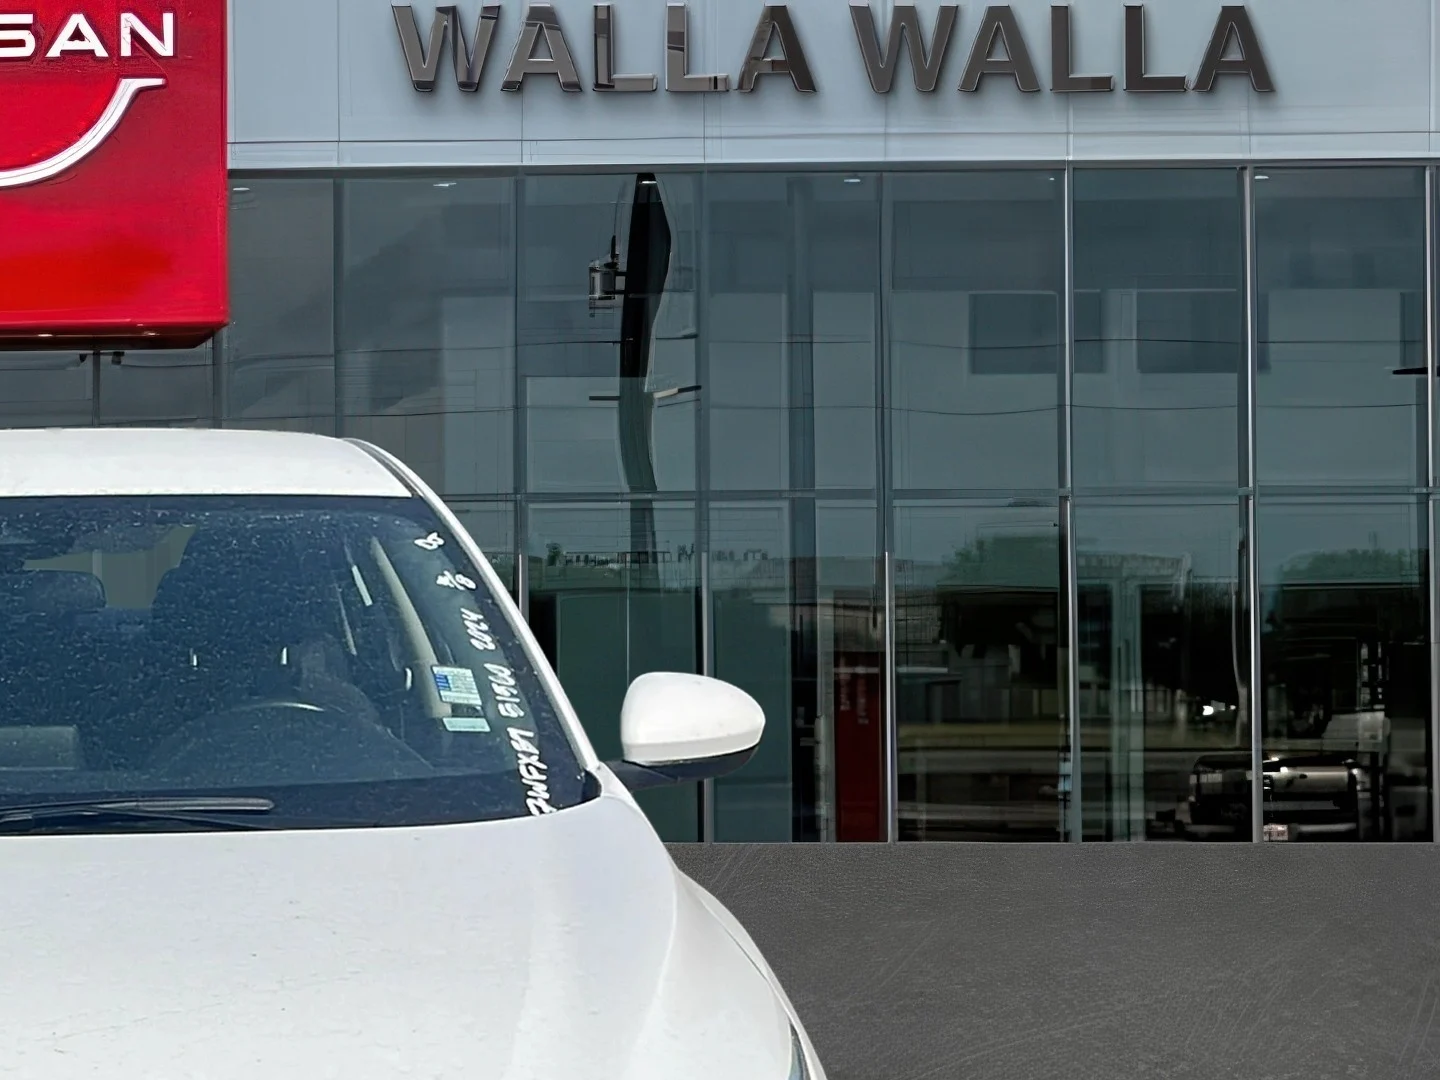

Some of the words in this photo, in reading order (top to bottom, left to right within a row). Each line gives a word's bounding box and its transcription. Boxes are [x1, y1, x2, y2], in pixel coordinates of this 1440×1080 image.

[391, 4, 818, 92] WALLA
[849, 4, 1277, 92] WALLA
[460, 607, 496, 651] 2024
